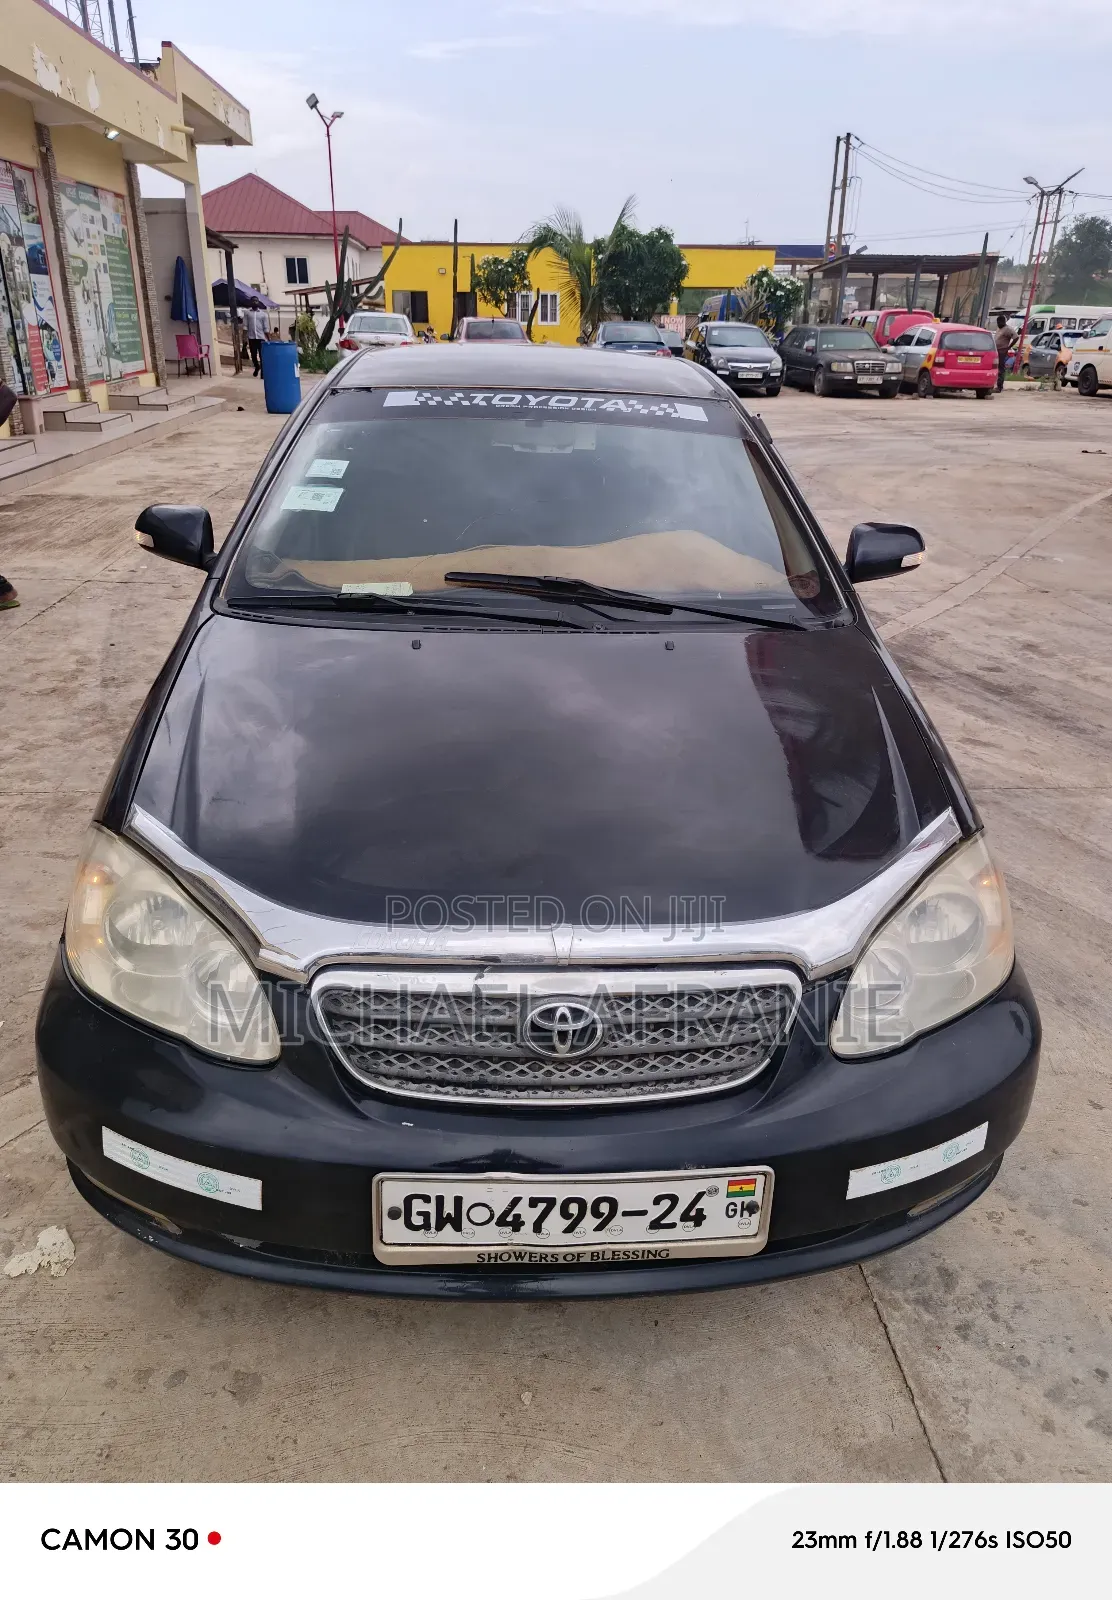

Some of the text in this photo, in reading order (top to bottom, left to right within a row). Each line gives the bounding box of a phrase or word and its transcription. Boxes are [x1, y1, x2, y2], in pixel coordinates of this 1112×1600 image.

[469, 393, 628, 412] TOYOTA
[403, 1190, 707, 1234] GW 4799-24
[725, 1200, 758, 1218] GH
[476, 1248, 670, 1263] SHOWERS OF BLESSING
